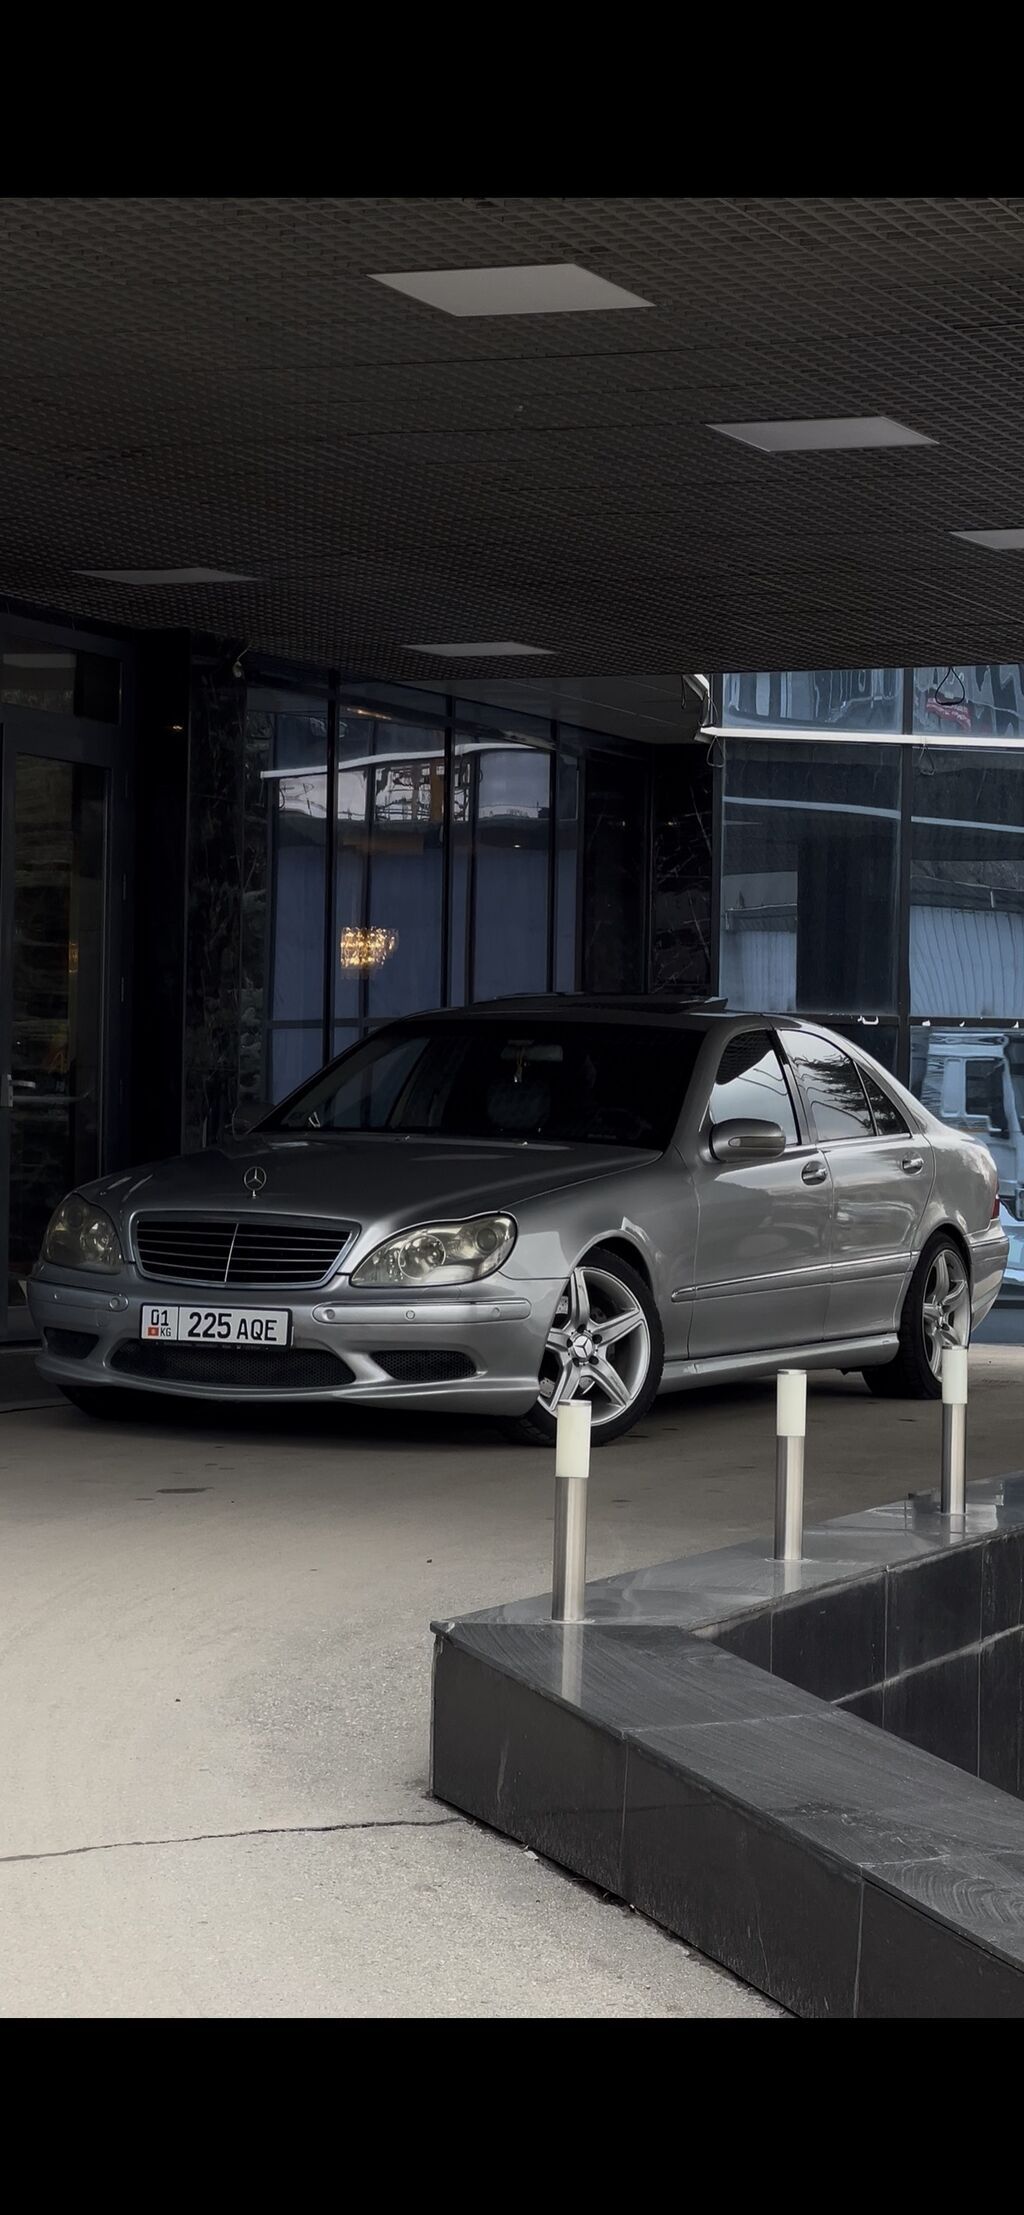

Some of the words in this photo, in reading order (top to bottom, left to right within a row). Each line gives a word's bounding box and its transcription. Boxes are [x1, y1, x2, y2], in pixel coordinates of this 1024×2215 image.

[151, 1309, 169, 1326] 01
[160, 1327, 171, 1337] KG
[187, 1312, 232, 1339] 225
[236, 1318, 277, 1341] AQE
